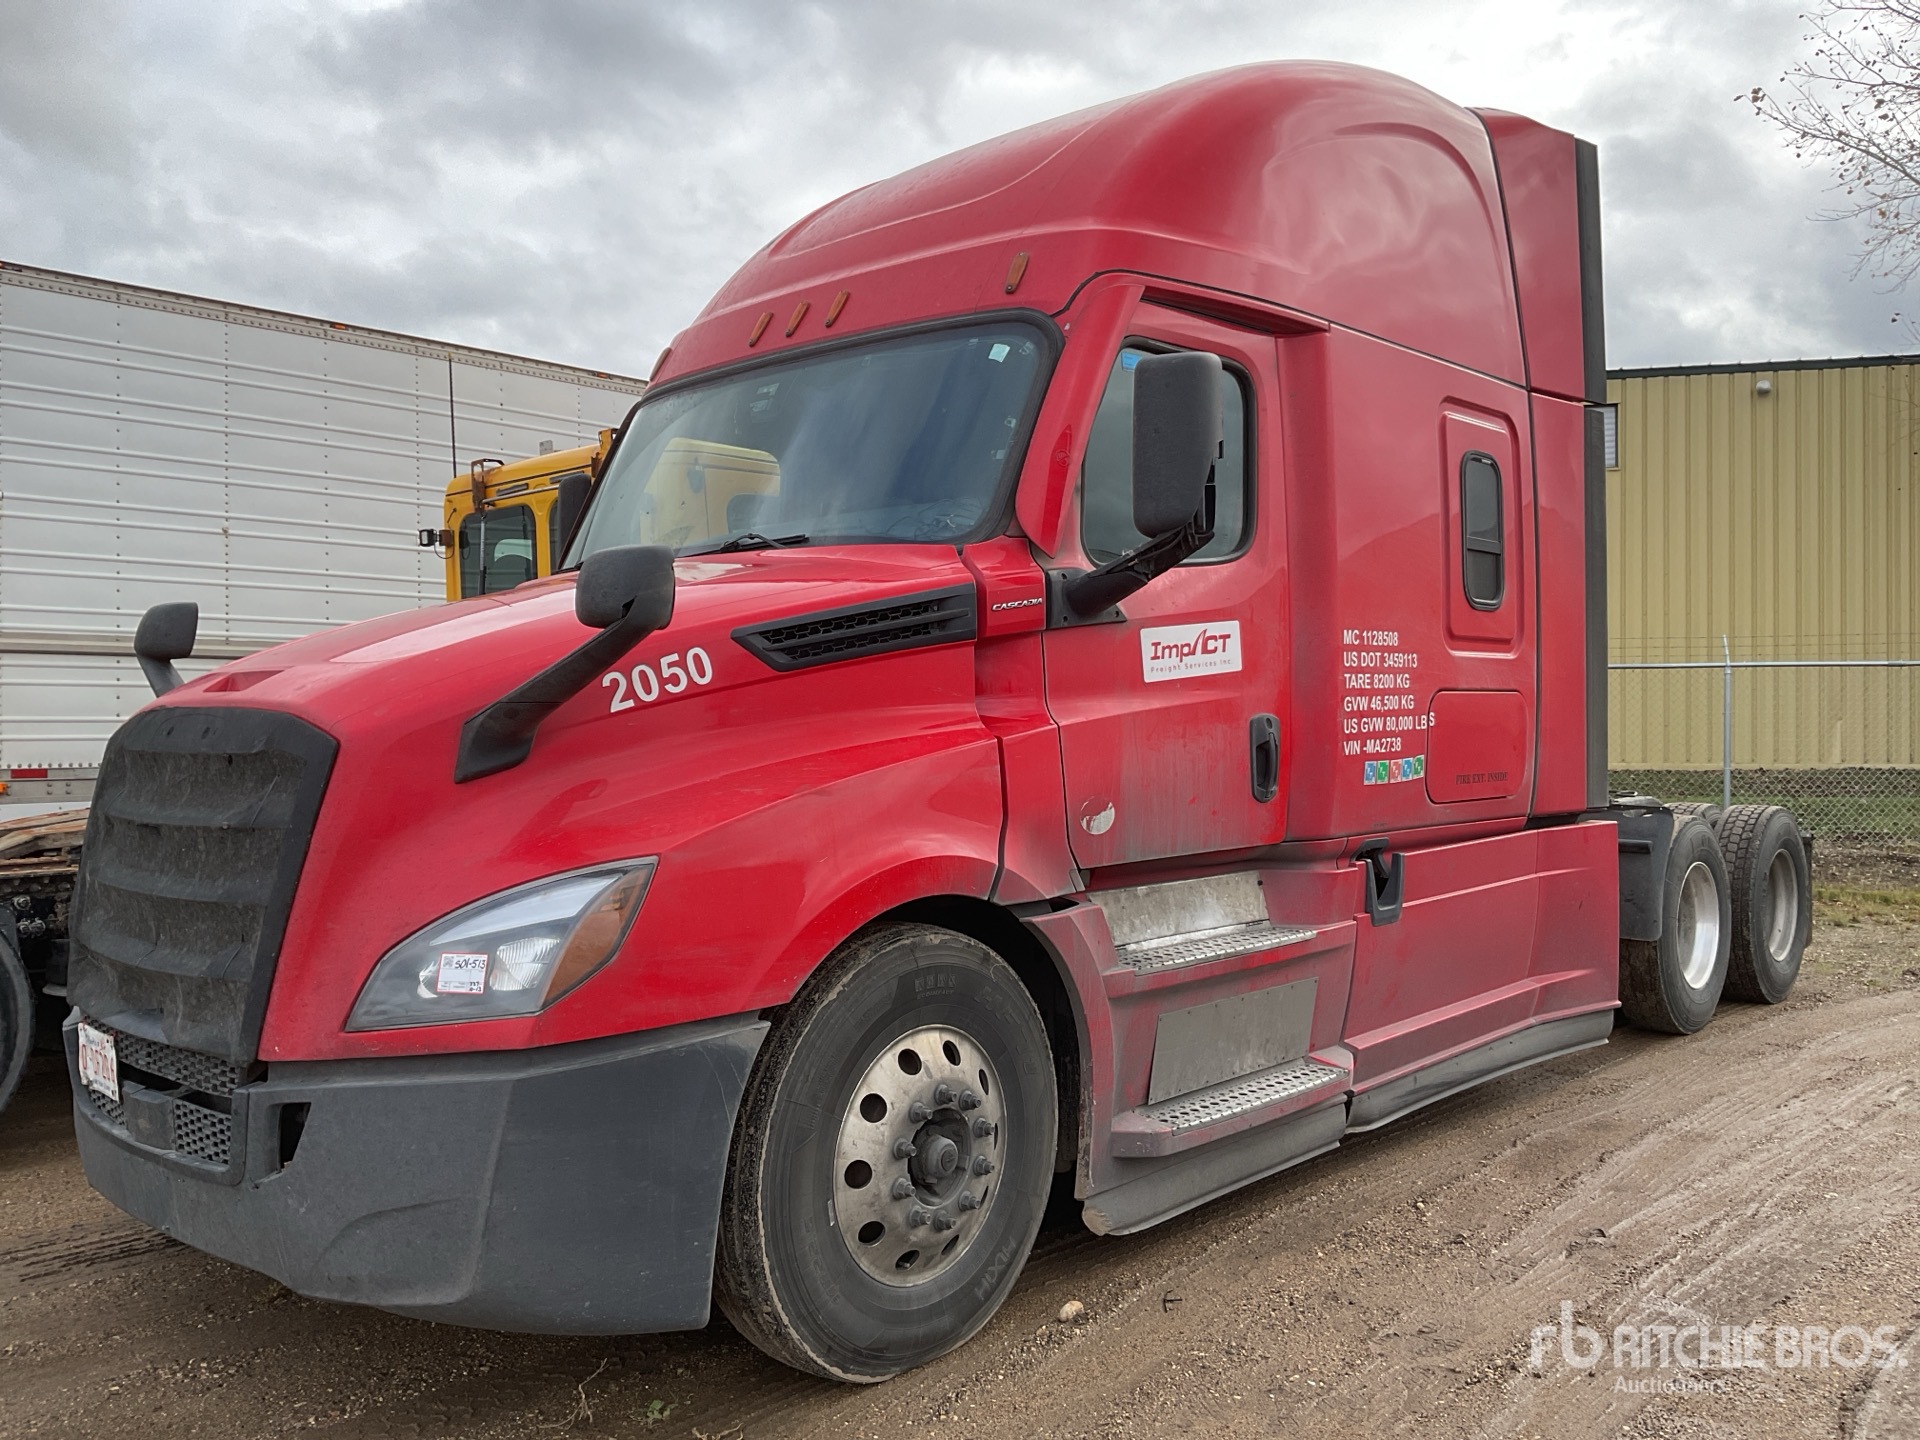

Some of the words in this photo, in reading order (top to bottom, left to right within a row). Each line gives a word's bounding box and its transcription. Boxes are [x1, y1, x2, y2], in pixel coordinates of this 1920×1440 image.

[992, 597, 1043, 611] CASCADIA
[1343, 629, 1360, 646] MC
[1362, 630, 1399, 646] 1128508
[1150, 663, 1181, 673] Freight
[1184, 660, 1217, 670] Services
[1343, 651, 1358, 667] US
[1360, 651, 1382, 667] DOT
[1383, 653, 1418, 668] 3459113
[602, 646, 713, 713] 2050
[1344, 673, 1371, 689] TARE
[1373, 673, 1395, 689] 8200
[1396, 673, 1410, 688] KG
[1344, 696, 1369, 712] GVW
[1370, 695, 1399, 713] 46,500
[1401, 694, 1414, 710] KG
[1344, 718, 1358, 734] US
[1360, 716, 1384, 733] GVW
[1386, 715, 1413, 733] 80,000
[1343, 740, 1361, 756] VIN
[1488, 772, 1508, 782] INSIDE
